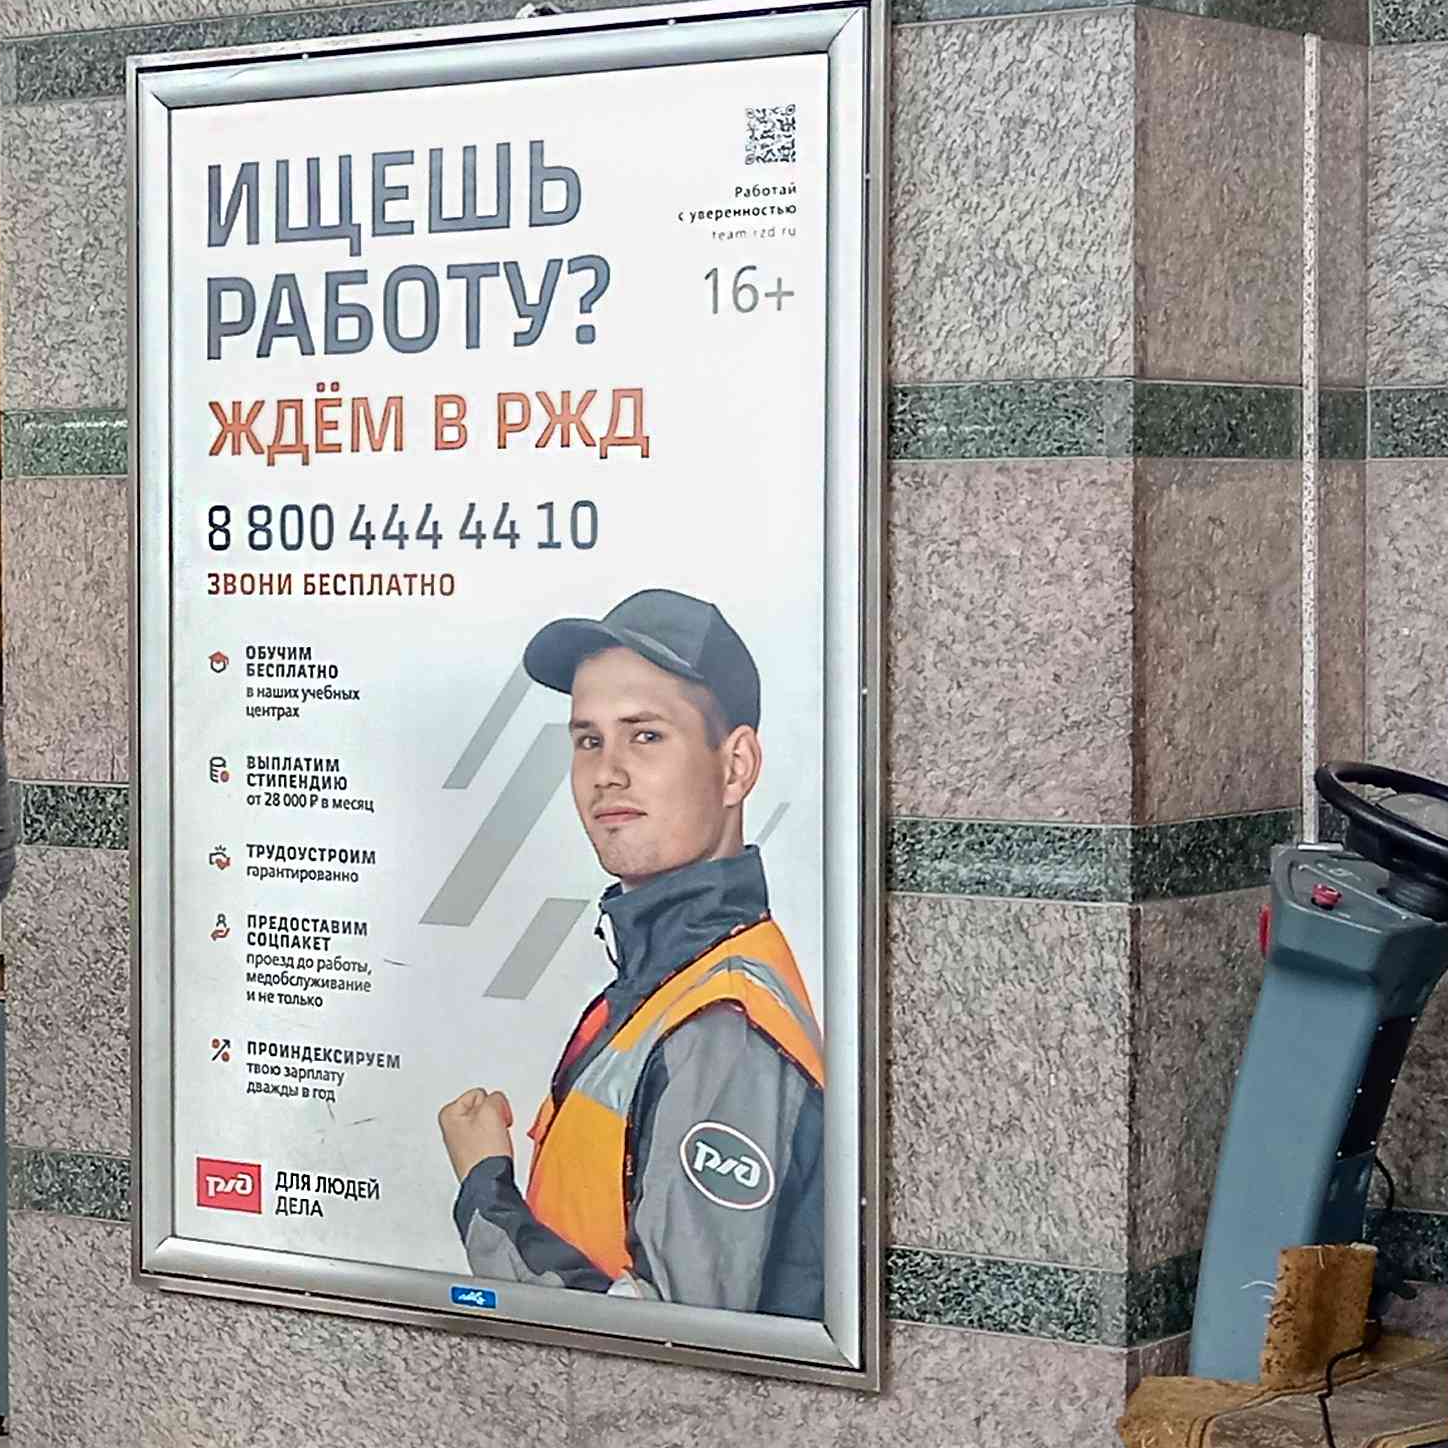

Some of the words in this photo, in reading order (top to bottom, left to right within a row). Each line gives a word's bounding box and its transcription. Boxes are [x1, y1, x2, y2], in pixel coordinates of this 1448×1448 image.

[207, 140, 583, 257] ИЩЕШЬ
[734, 182, 797, 199] Работай
[689, 203, 797, 223] уверенностью
[704, 265, 795, 314] 16+
[207, 254, 612, 360] РАБОТУ?
[208, 381, 404, 467] ЖДЁМ
[435, 395, 468, 451] В
[497, 387, 651, 460] РЖД
[207, 504, 232, 552] 8
[247, 503, 335, 552] 800
[349, 502, 443, 551] 444
[457, 501, 521, 550] 44
[536, 499, 599, 551] 10
[207, 572, 292, 596] ЗВОНИ
[304, 572, 455, 597] БЕСПЛАТНО
[246, 645, 312, 661] ОБУЧИМ
[246, 663, 339, 680] БЕСПЛАТНО
[246, 686, 254, 698] в
[256, 687, 299, 700] наших
[301, 686, 360, 702] учебных
[246, 705, 300, 721] центрах
[246, 755, 340, 772] ВЫПЛАТИМ
[246, 774, 347, 792] СТИПЕНДИЮ
[246, 795, 262, 806] от
[264, 793, 282, 807] 28
[283, 794, 307, 808] 000
[321, 798, 330, 809] в
[331, 798, 375, 813] месяц
[246, 843, 376, 865] ТРУДОУСТРОИМ
[246, 866, 359, 883] гарантированно
[246, 914, 368, 937] ПРЕДОСТАВИМ
[246, 932, 331, 952] СОЦПАКЕТ
[246, 954, 294, 970] проезд
[296, 957, 314, 971] до
[316, 956, 373, 975] работы,
[246, 971, 372, 993] медобслуживание
[246, 991, 255, 1002] и
[258, 992, 276, 1004] не
[277, 993, 324, 1008] только
[246, 1040, 401, 1070] ПРОИНДЕКСИРУЕМ
[246, 1063, 281, 1076] твою
[283, 1066, 345, 1086] зарплату
[246, 1081, 299, 1098] дважды
[301, 1086, 309, 1098] в
[312, 1087, 336, 1103] год
[274, 1171, 311, 1193] ДЛЯ
[314, 1173, 380, 1201] ЛЮДЕЙ
[274, 1195, 324, 1217] ДЕЛА
